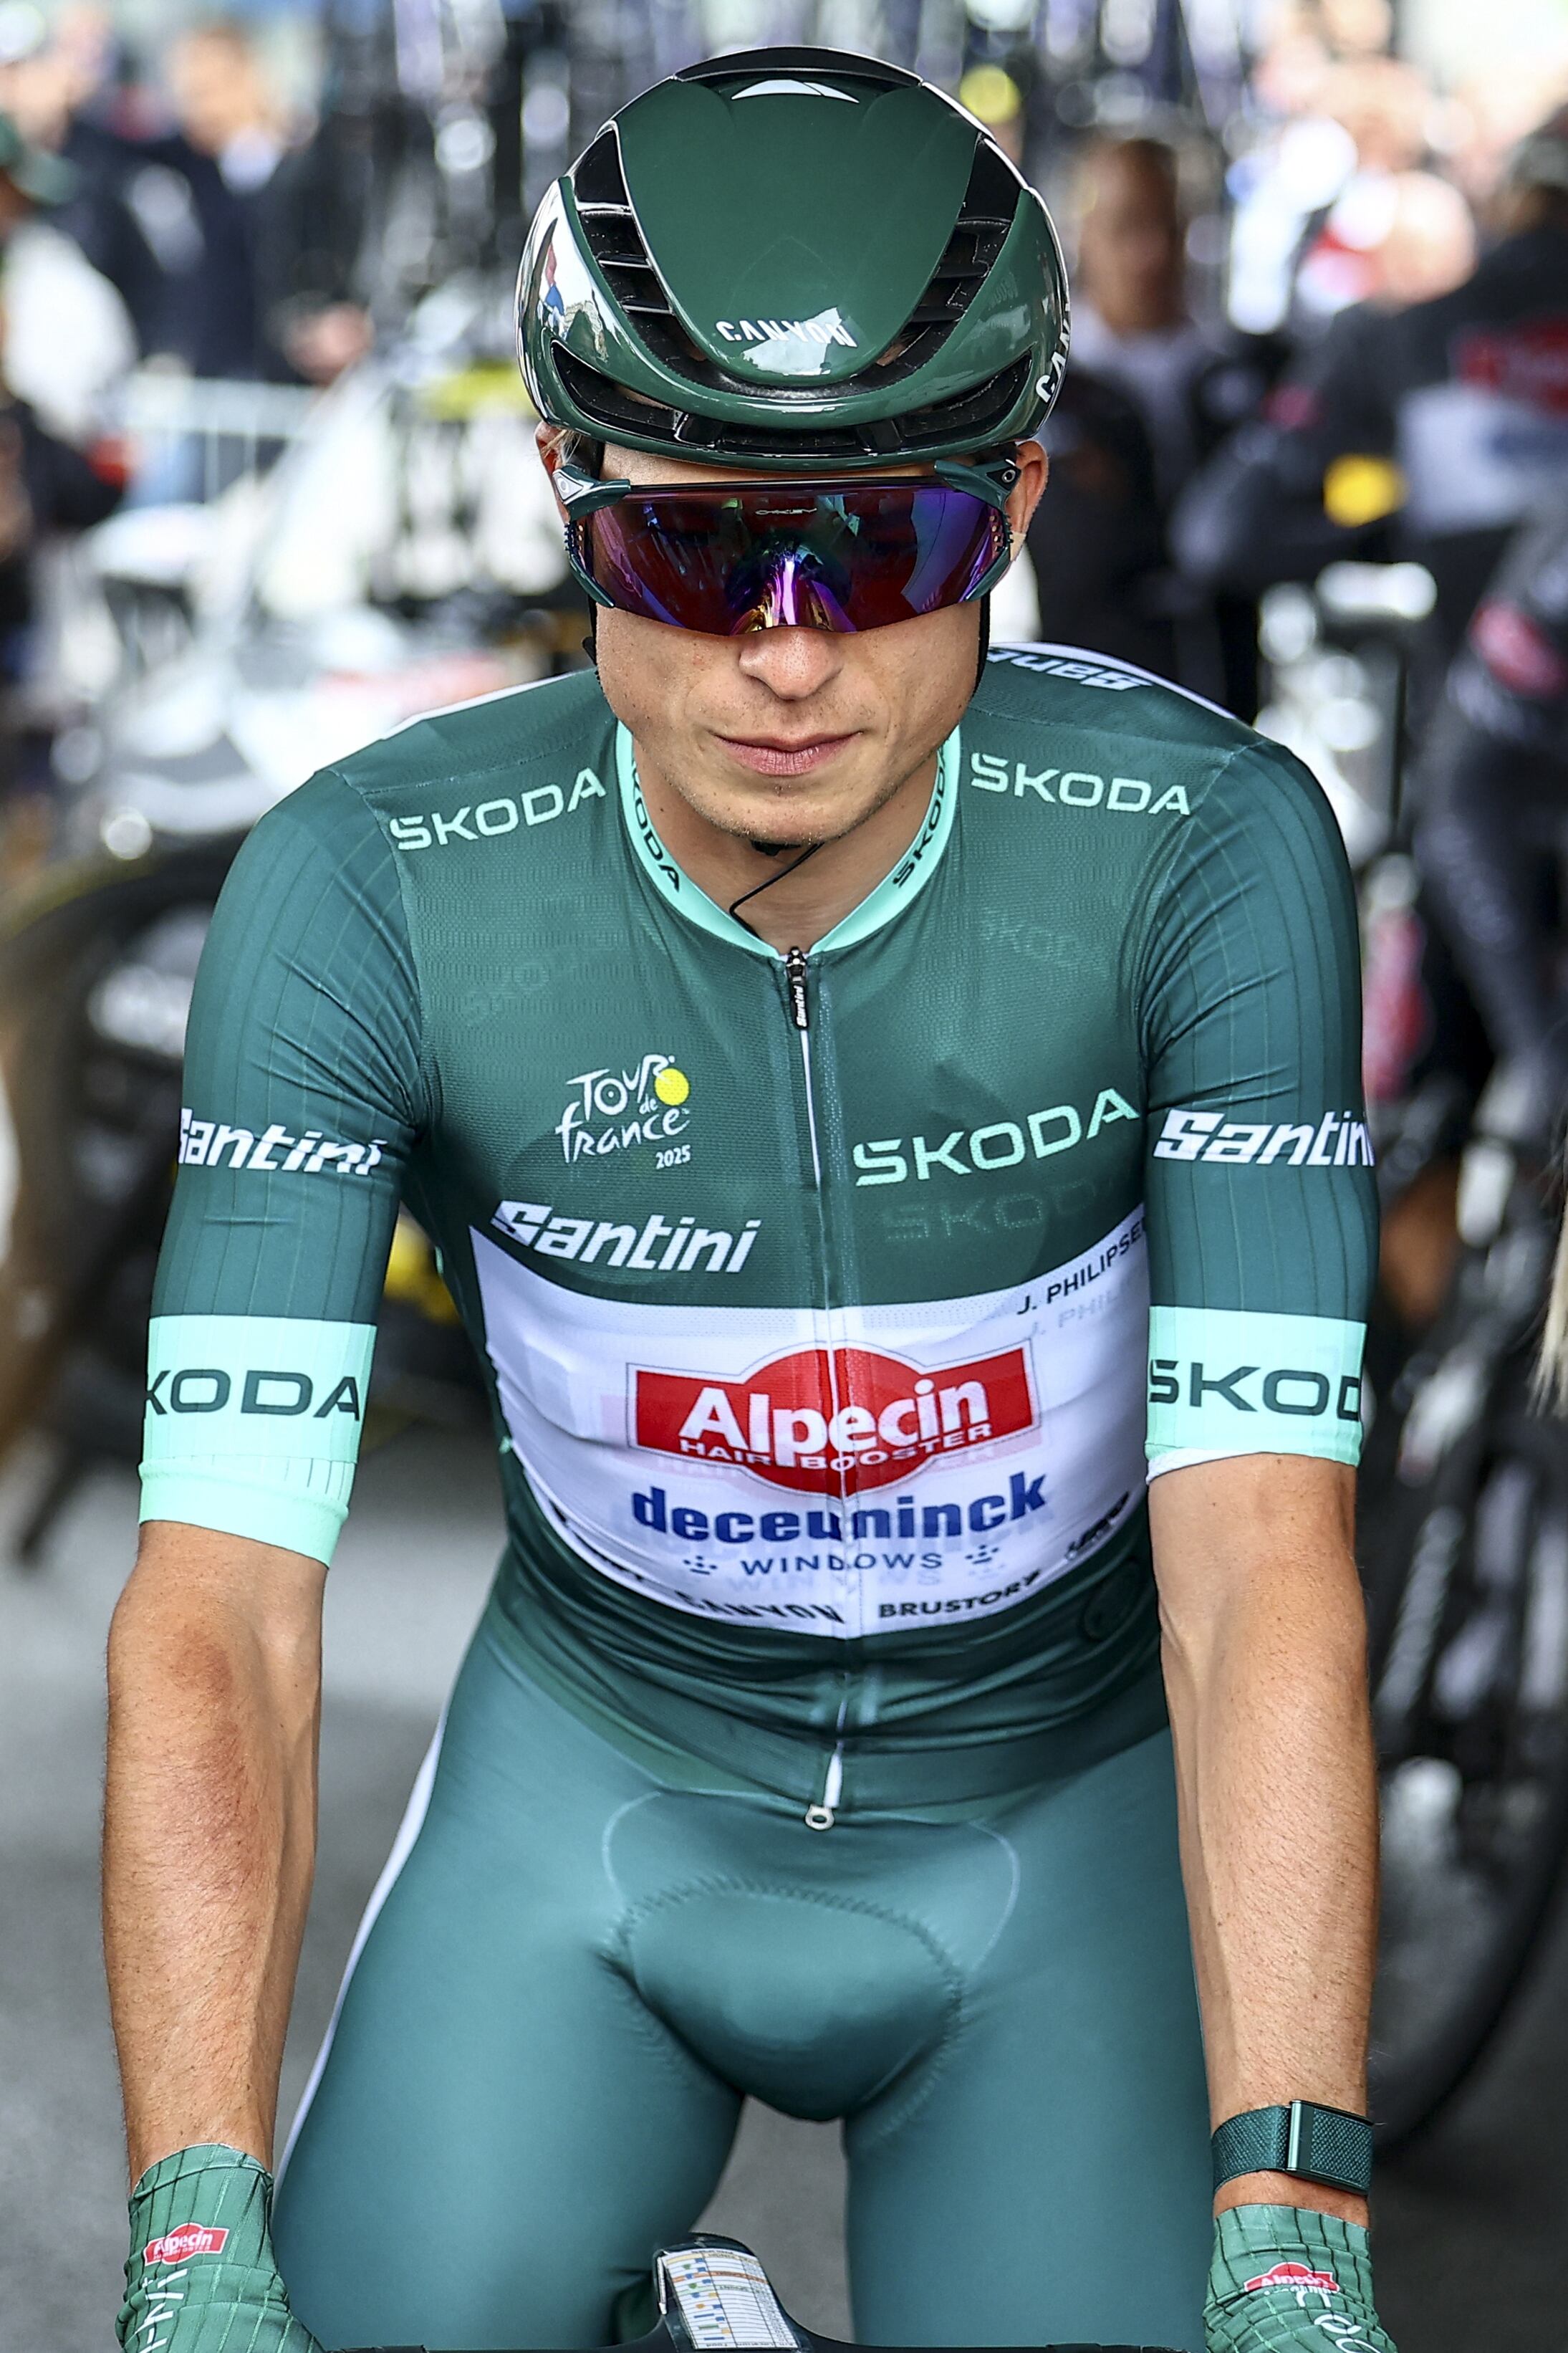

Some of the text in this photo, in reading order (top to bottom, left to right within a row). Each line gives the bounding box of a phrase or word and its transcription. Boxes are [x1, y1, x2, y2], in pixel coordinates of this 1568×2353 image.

[716, 320, 858, 348] CANYON
[390, 767, 607, 851] SKODA
[971, 752, 1193, 816] SKODA
[639, 1093, 658, 1115] de
[655, 1144, 691, 1170] 2025
[852, 1087, 1140, 1187] SKODA
[1153, 1108, 1375, 1167] Santin
[490, 1199, 762, 1274] Santini
[1016, 1215, 1148, 1316] J. PHILIPSE
[678, 1378, 990, 1468] Alpecin
[680, 1423, 992, 1472] HAIR BOOSTER
[631, 1471, 1047, 1543] deceuninck
[740, 1552, 942, 1576] WINDOWS
[153, 2230, 213, 2256] Alpecin
